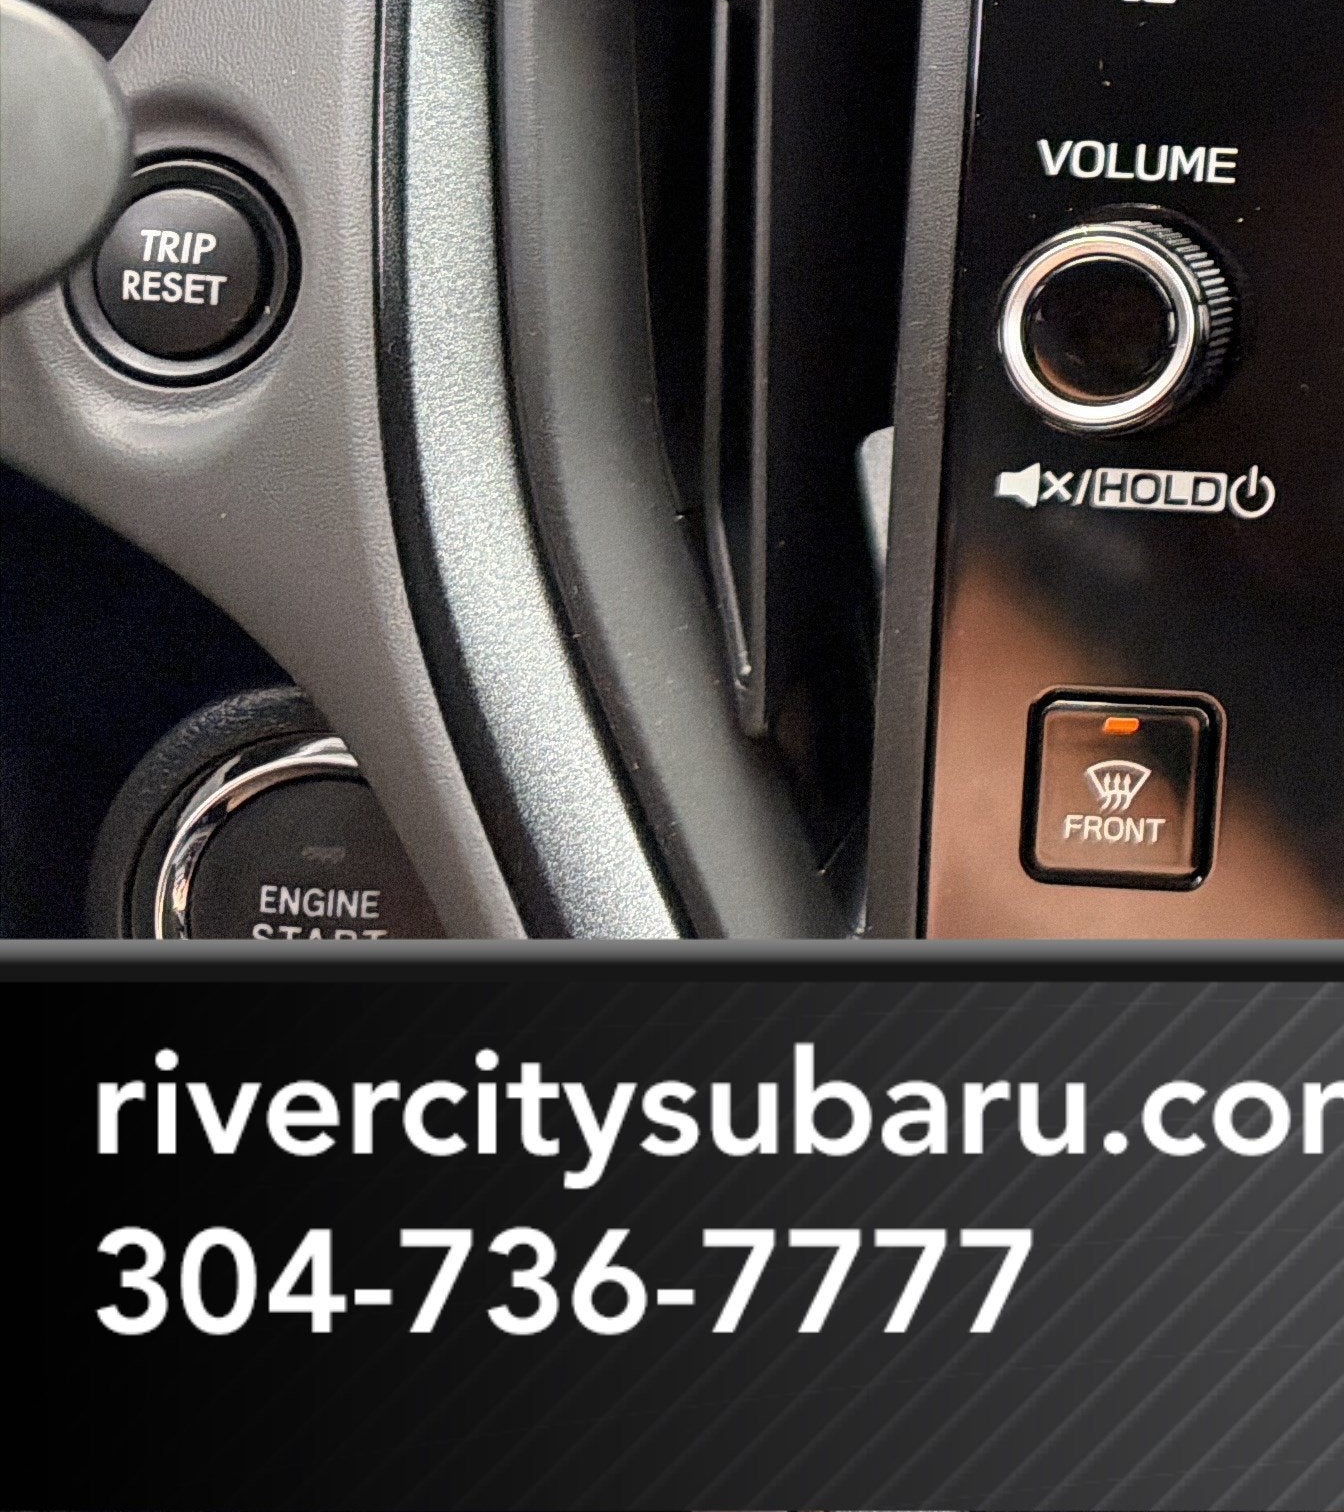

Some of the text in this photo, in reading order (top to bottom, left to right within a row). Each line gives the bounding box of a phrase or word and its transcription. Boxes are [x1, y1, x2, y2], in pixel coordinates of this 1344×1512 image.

[1037, 138, 1239, 184] VOLUME
[141, 229, 217, 265] TRIP
[122, 269, 228, 306] RESET
[1062, 814, 1167, 844] FRONT
[259, 884, 381, 919] ENGINE
